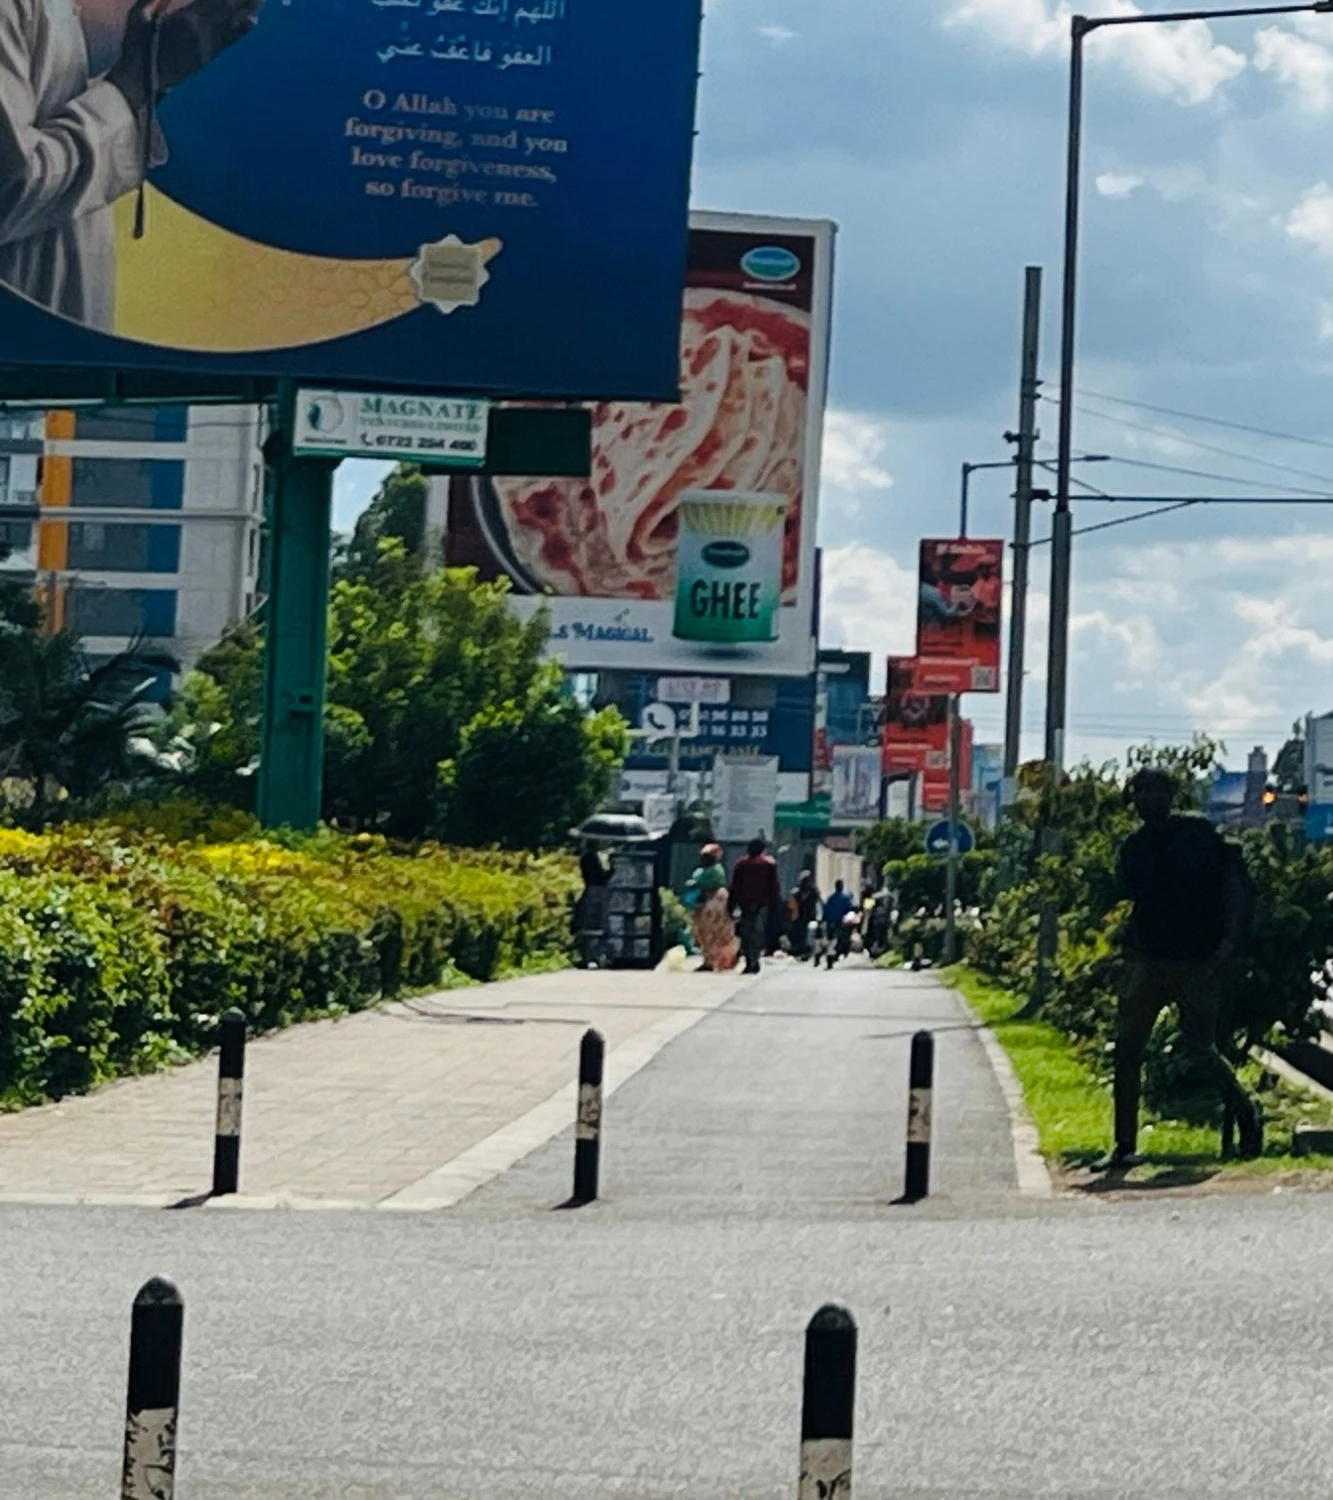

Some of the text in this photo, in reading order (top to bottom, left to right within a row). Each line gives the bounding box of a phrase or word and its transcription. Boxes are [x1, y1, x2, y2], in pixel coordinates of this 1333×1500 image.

[363, 89, 556, 124] O Allah you are
[471, 129, 518, 150] and
[523, 135, 569, 156] you
[352, 146, 558, 184] love forgiveness,
[365, 177, 541, 208] so forgive me.
[690, 578, 762, 620] GHEE
